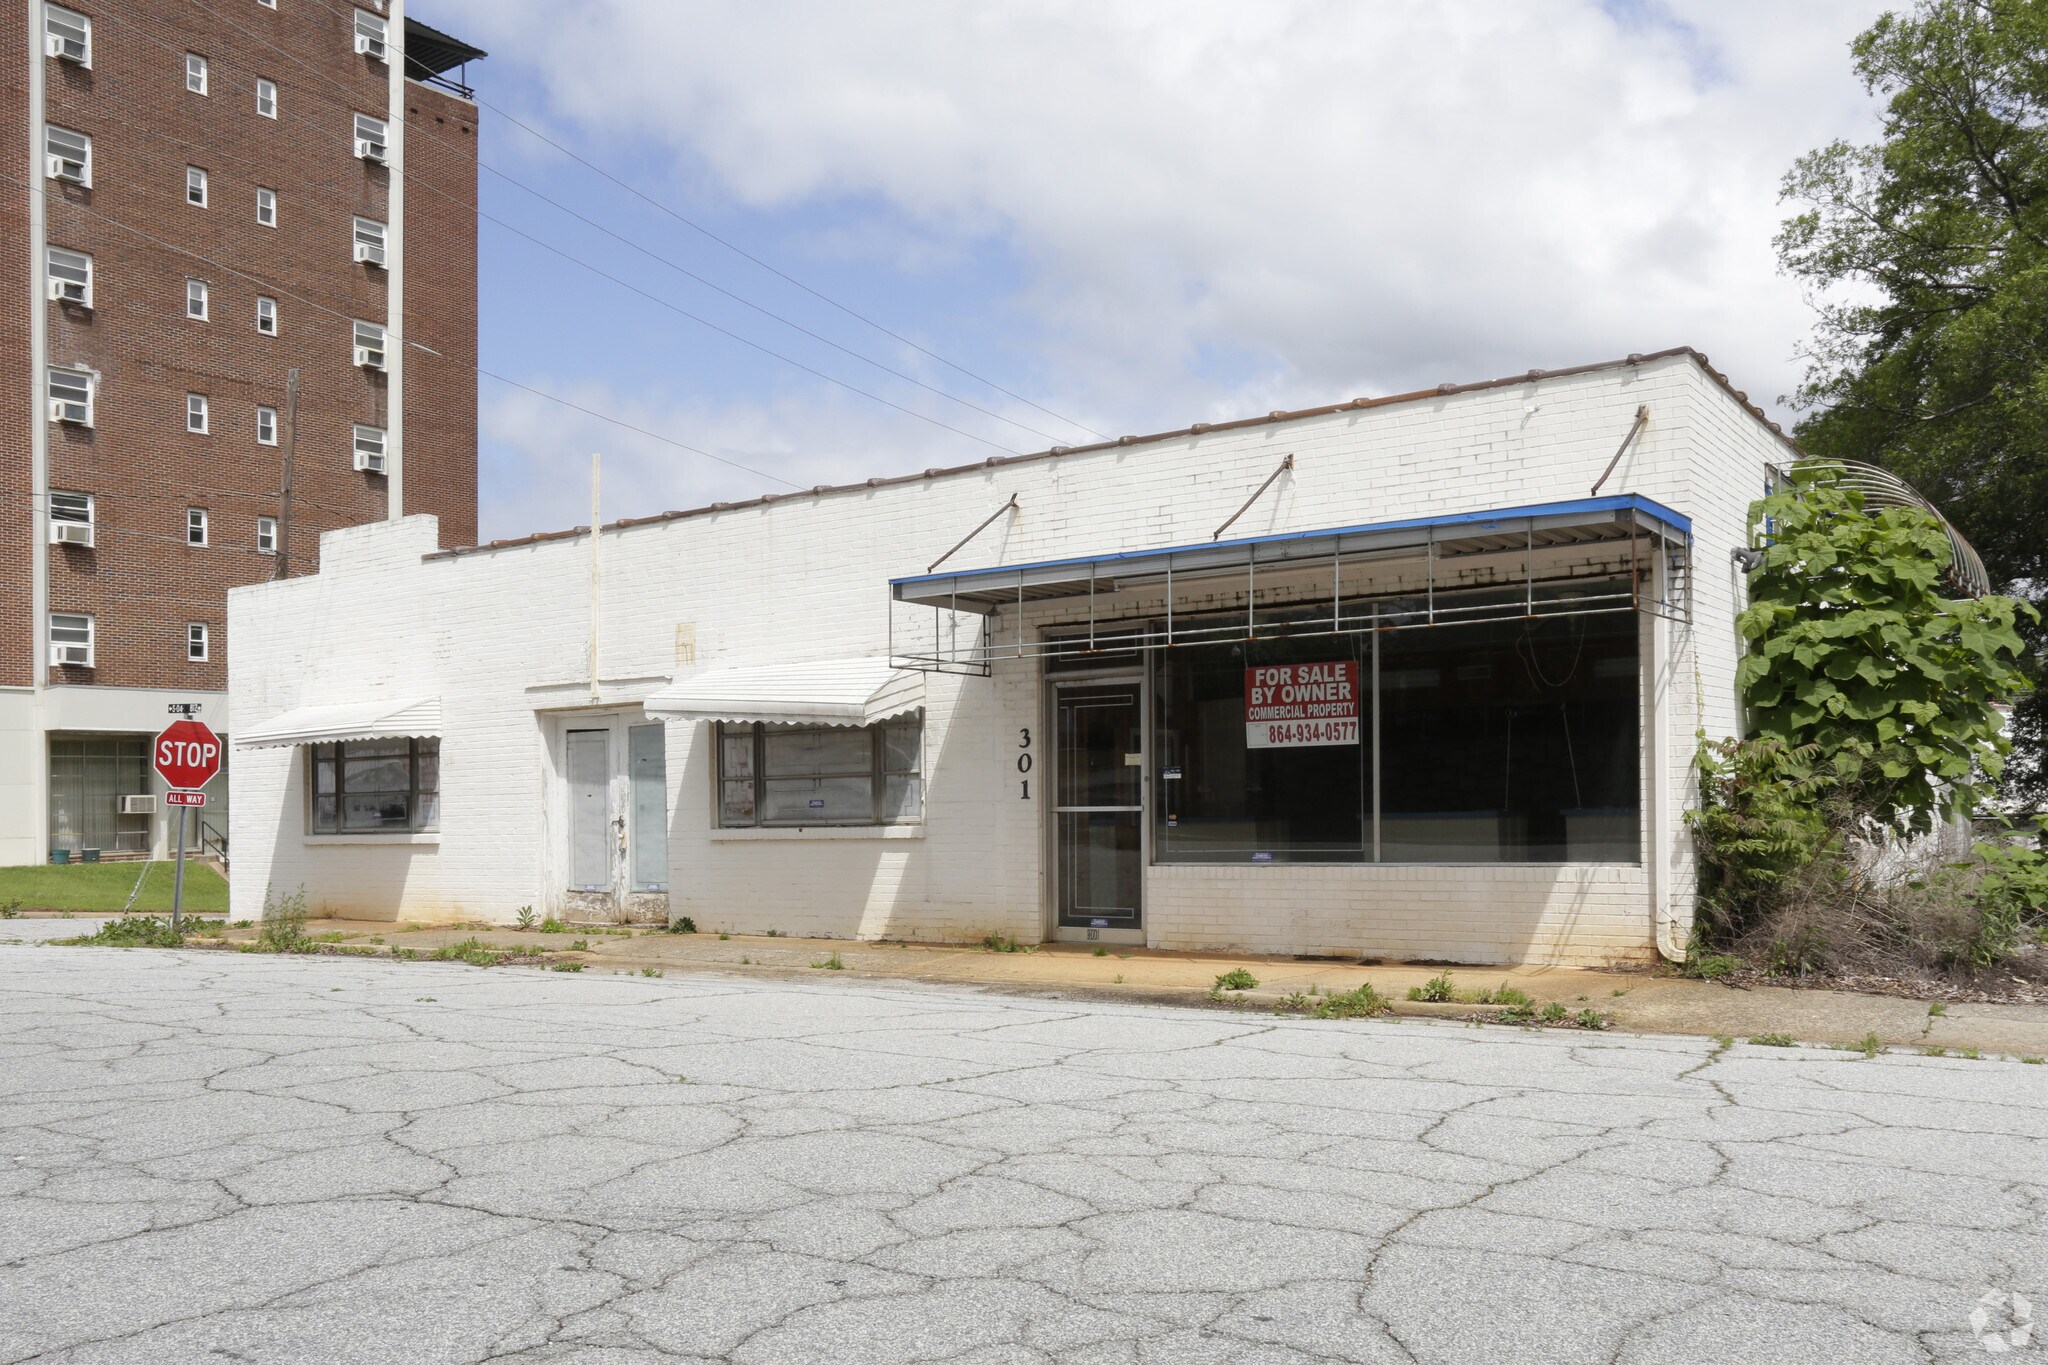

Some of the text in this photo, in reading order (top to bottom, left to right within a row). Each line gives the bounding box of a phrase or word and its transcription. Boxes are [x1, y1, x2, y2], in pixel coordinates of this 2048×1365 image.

[1255, 664, 1346, 687] FOR SALE
[1251, 682, 1352, 705] BY OWNER
[1248, 702, 1355, 720] COMMERCIAL PROPERTY
[1269, 721, 1357, 744] 864-934-0577
[159, 740, 217, 768] STOP
[168, 794, 203, 804] ALL WAY
